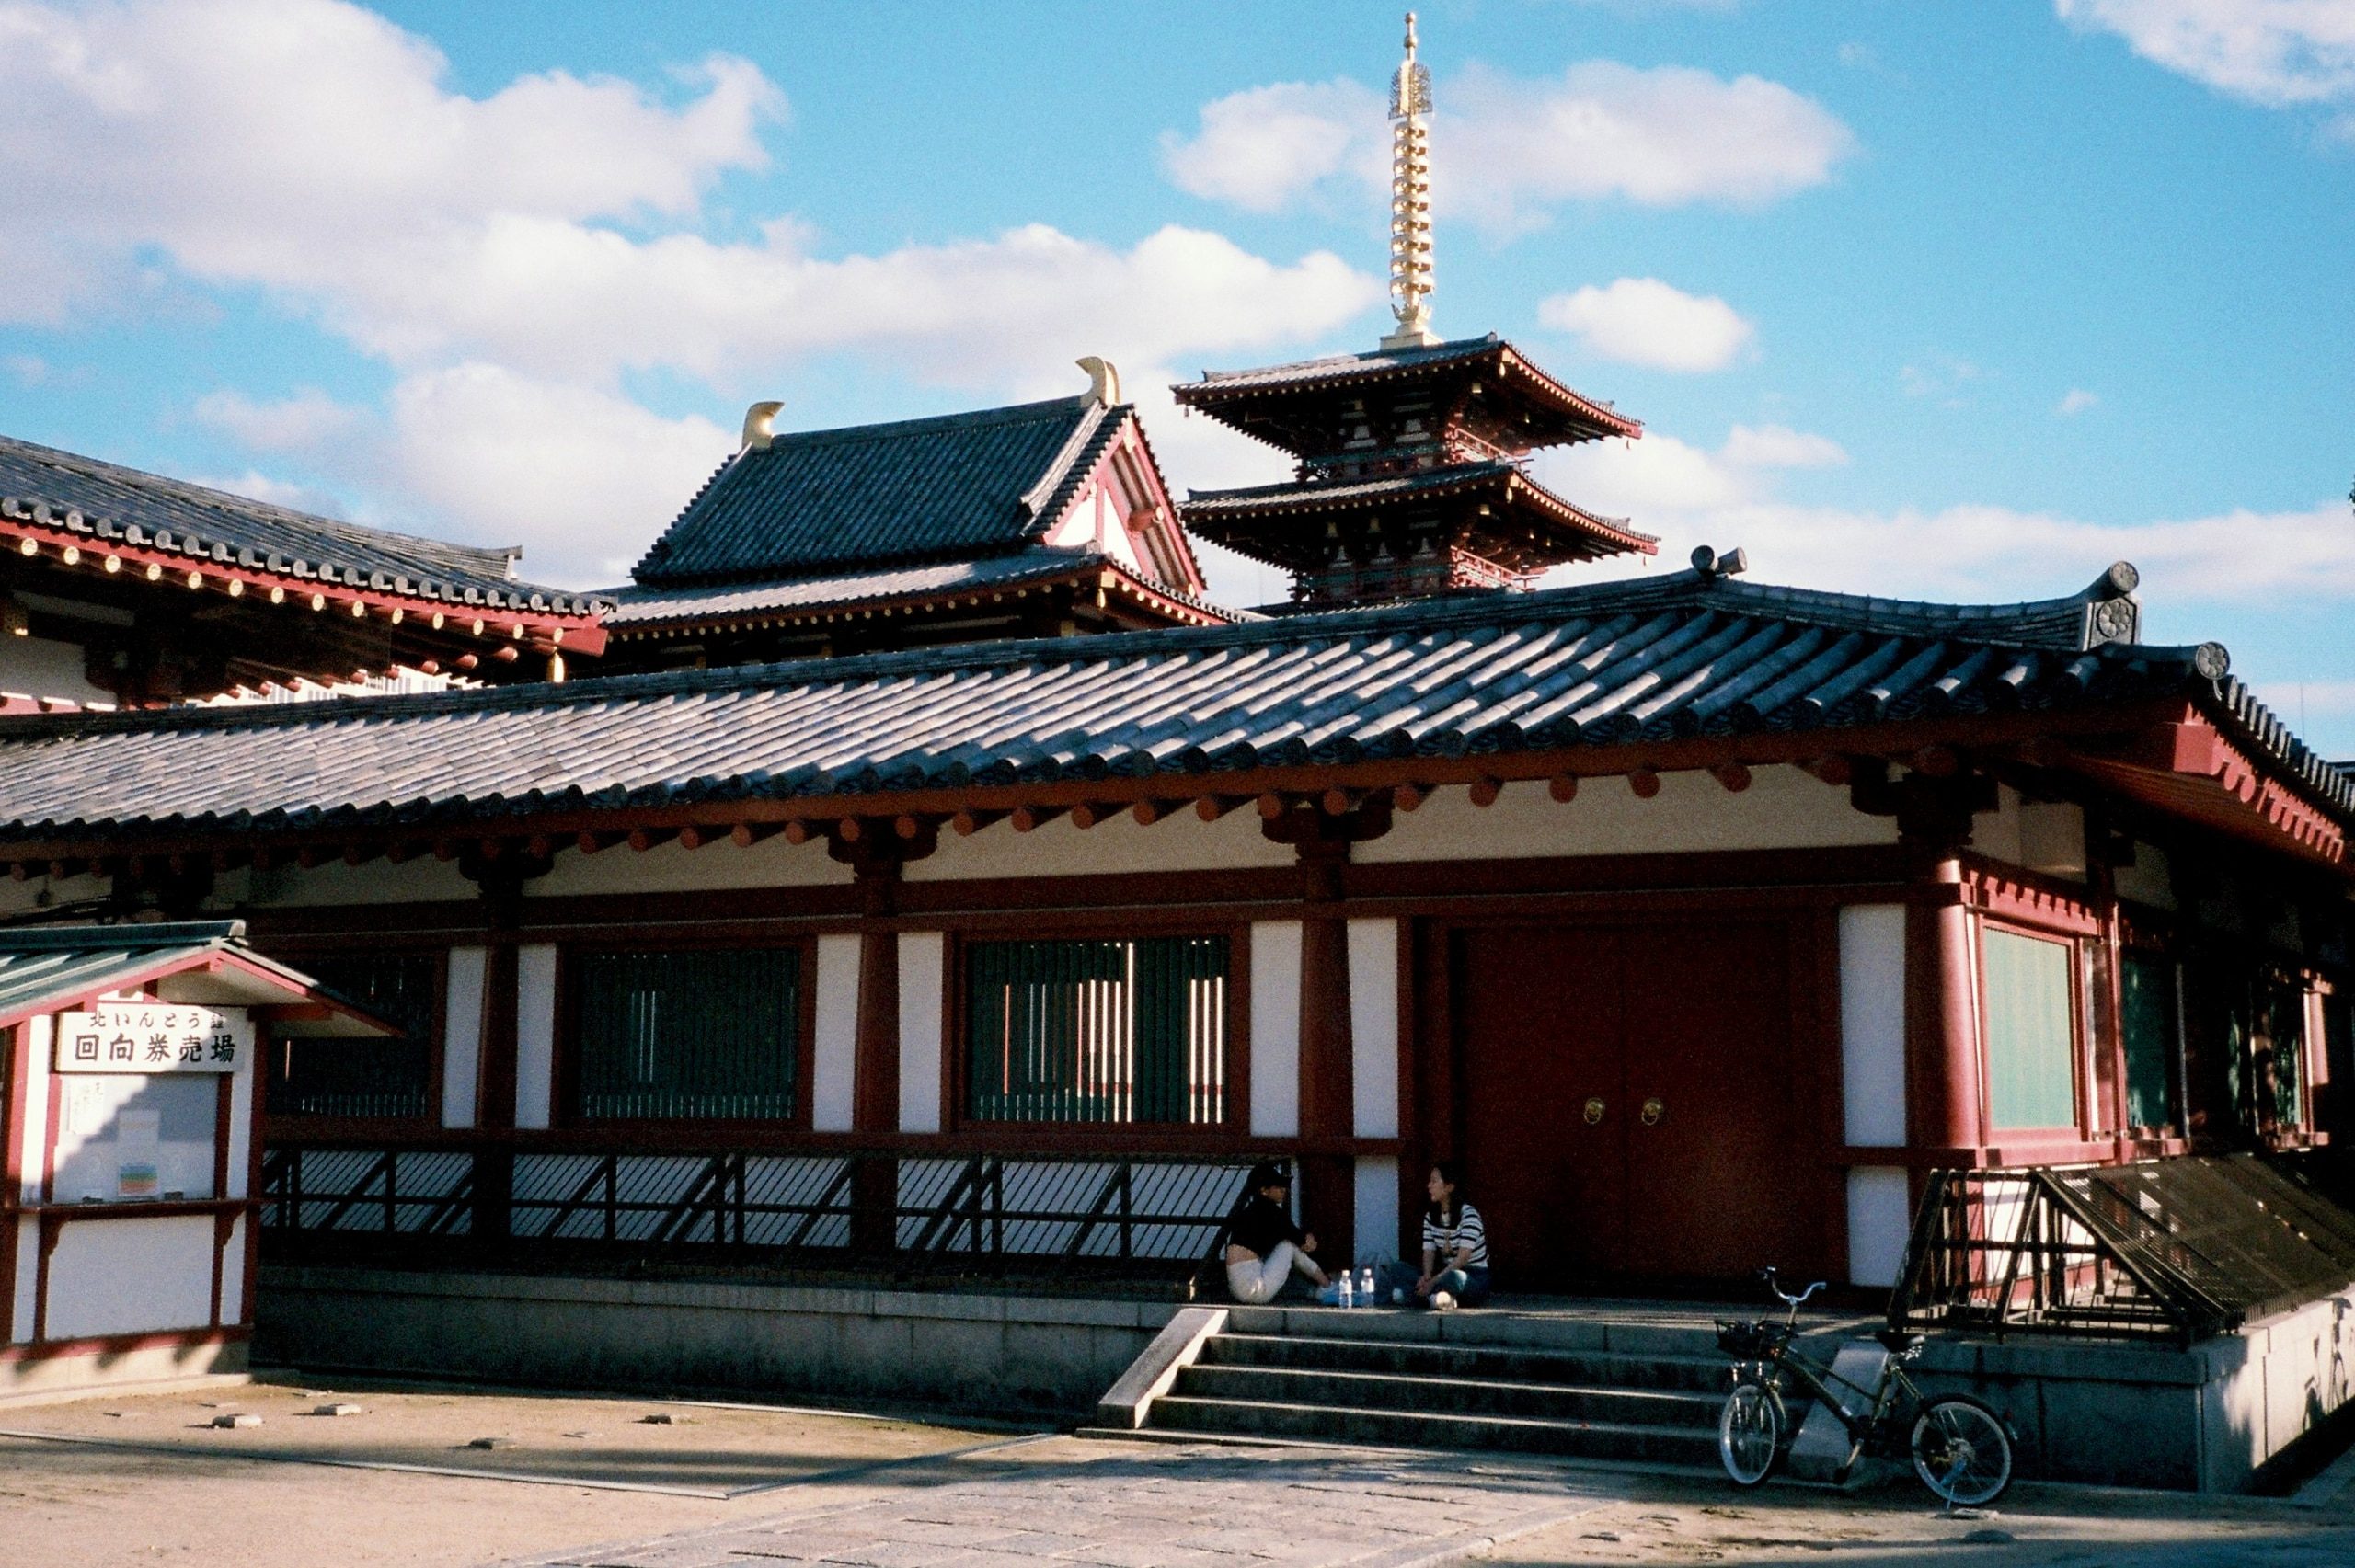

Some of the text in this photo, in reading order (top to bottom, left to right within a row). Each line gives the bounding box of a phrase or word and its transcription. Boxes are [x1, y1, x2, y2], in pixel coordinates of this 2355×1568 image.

[75, 1033, 236, 1062] 回向券売場
